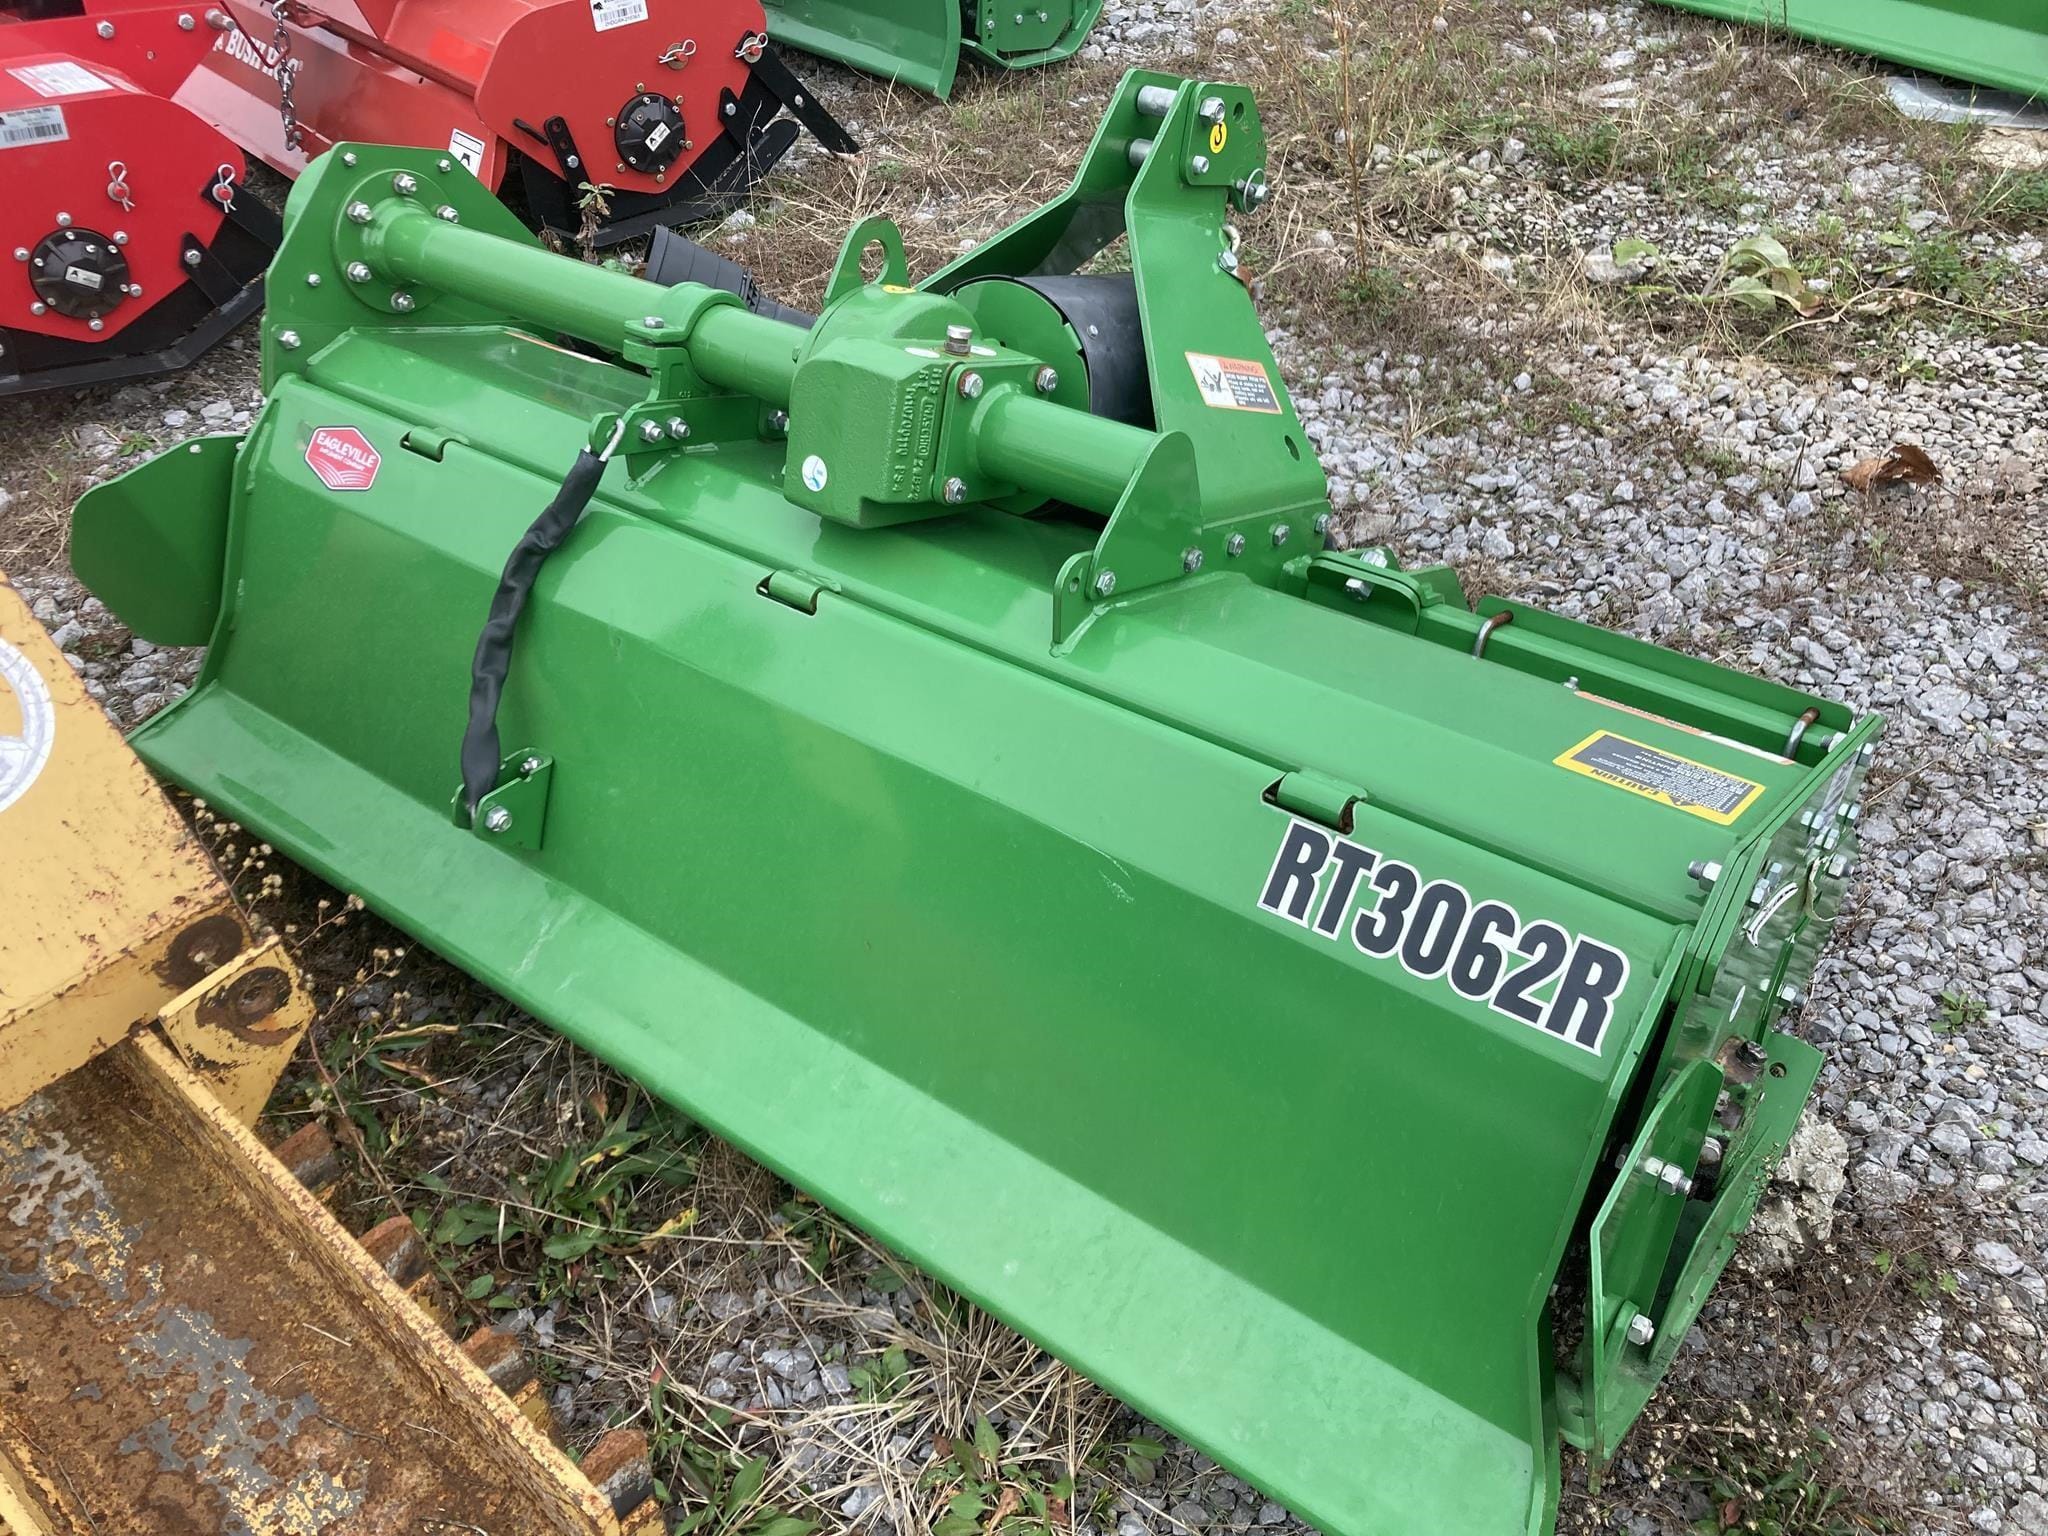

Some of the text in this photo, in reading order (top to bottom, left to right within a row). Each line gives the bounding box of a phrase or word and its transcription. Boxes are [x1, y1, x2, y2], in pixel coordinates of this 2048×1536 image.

[316, 431, 378, 468] EAGLEVILLE
[918, 404, 935, 456] MASCHIO
[1590, 767, 1660, 796] CAUTION
[1260, 821, 1627, 1051] RT3062R
